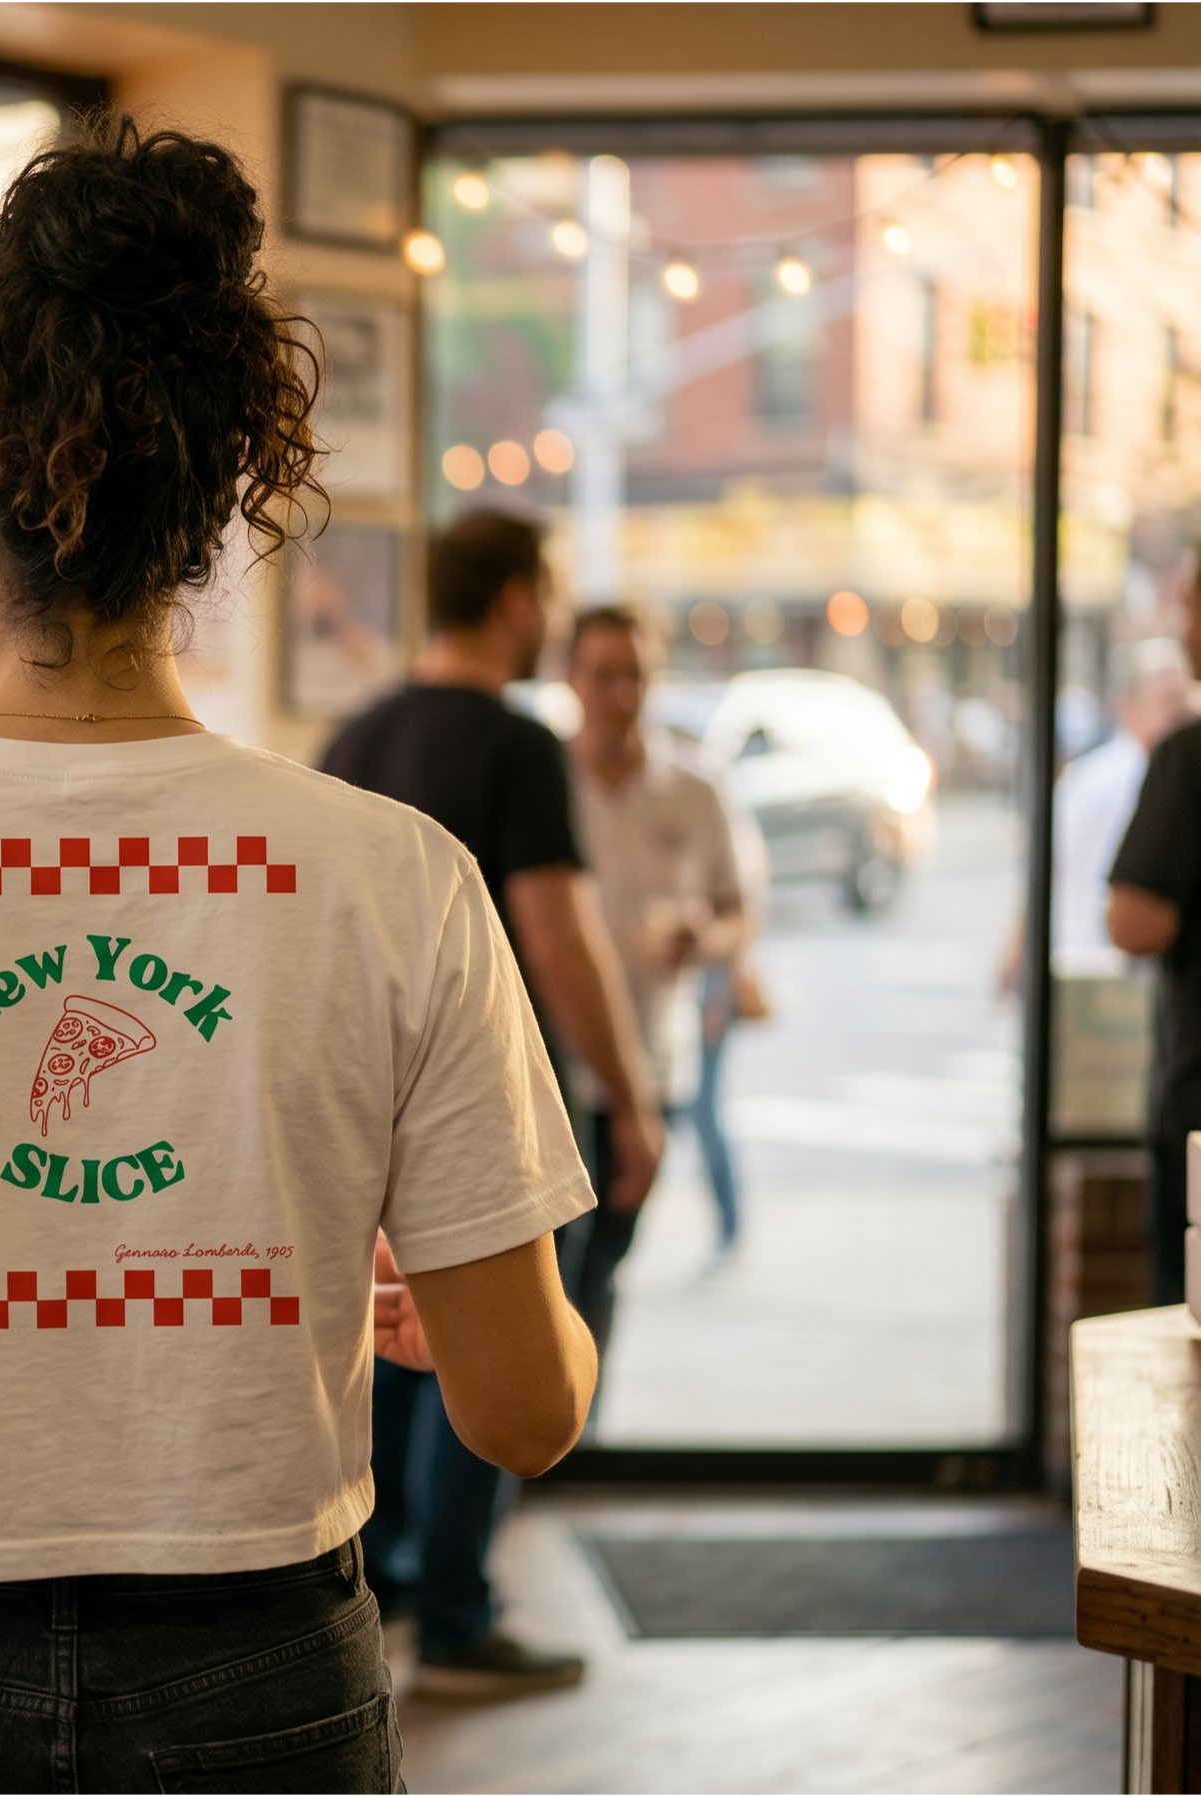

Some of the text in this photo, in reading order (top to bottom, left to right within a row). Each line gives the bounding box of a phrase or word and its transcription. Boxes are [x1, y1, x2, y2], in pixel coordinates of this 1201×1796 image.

[86, 933, 233, 1043] York
[0, 1139, 186, 1204] SLICE
[265, 1245, 295, 1260] 1905
